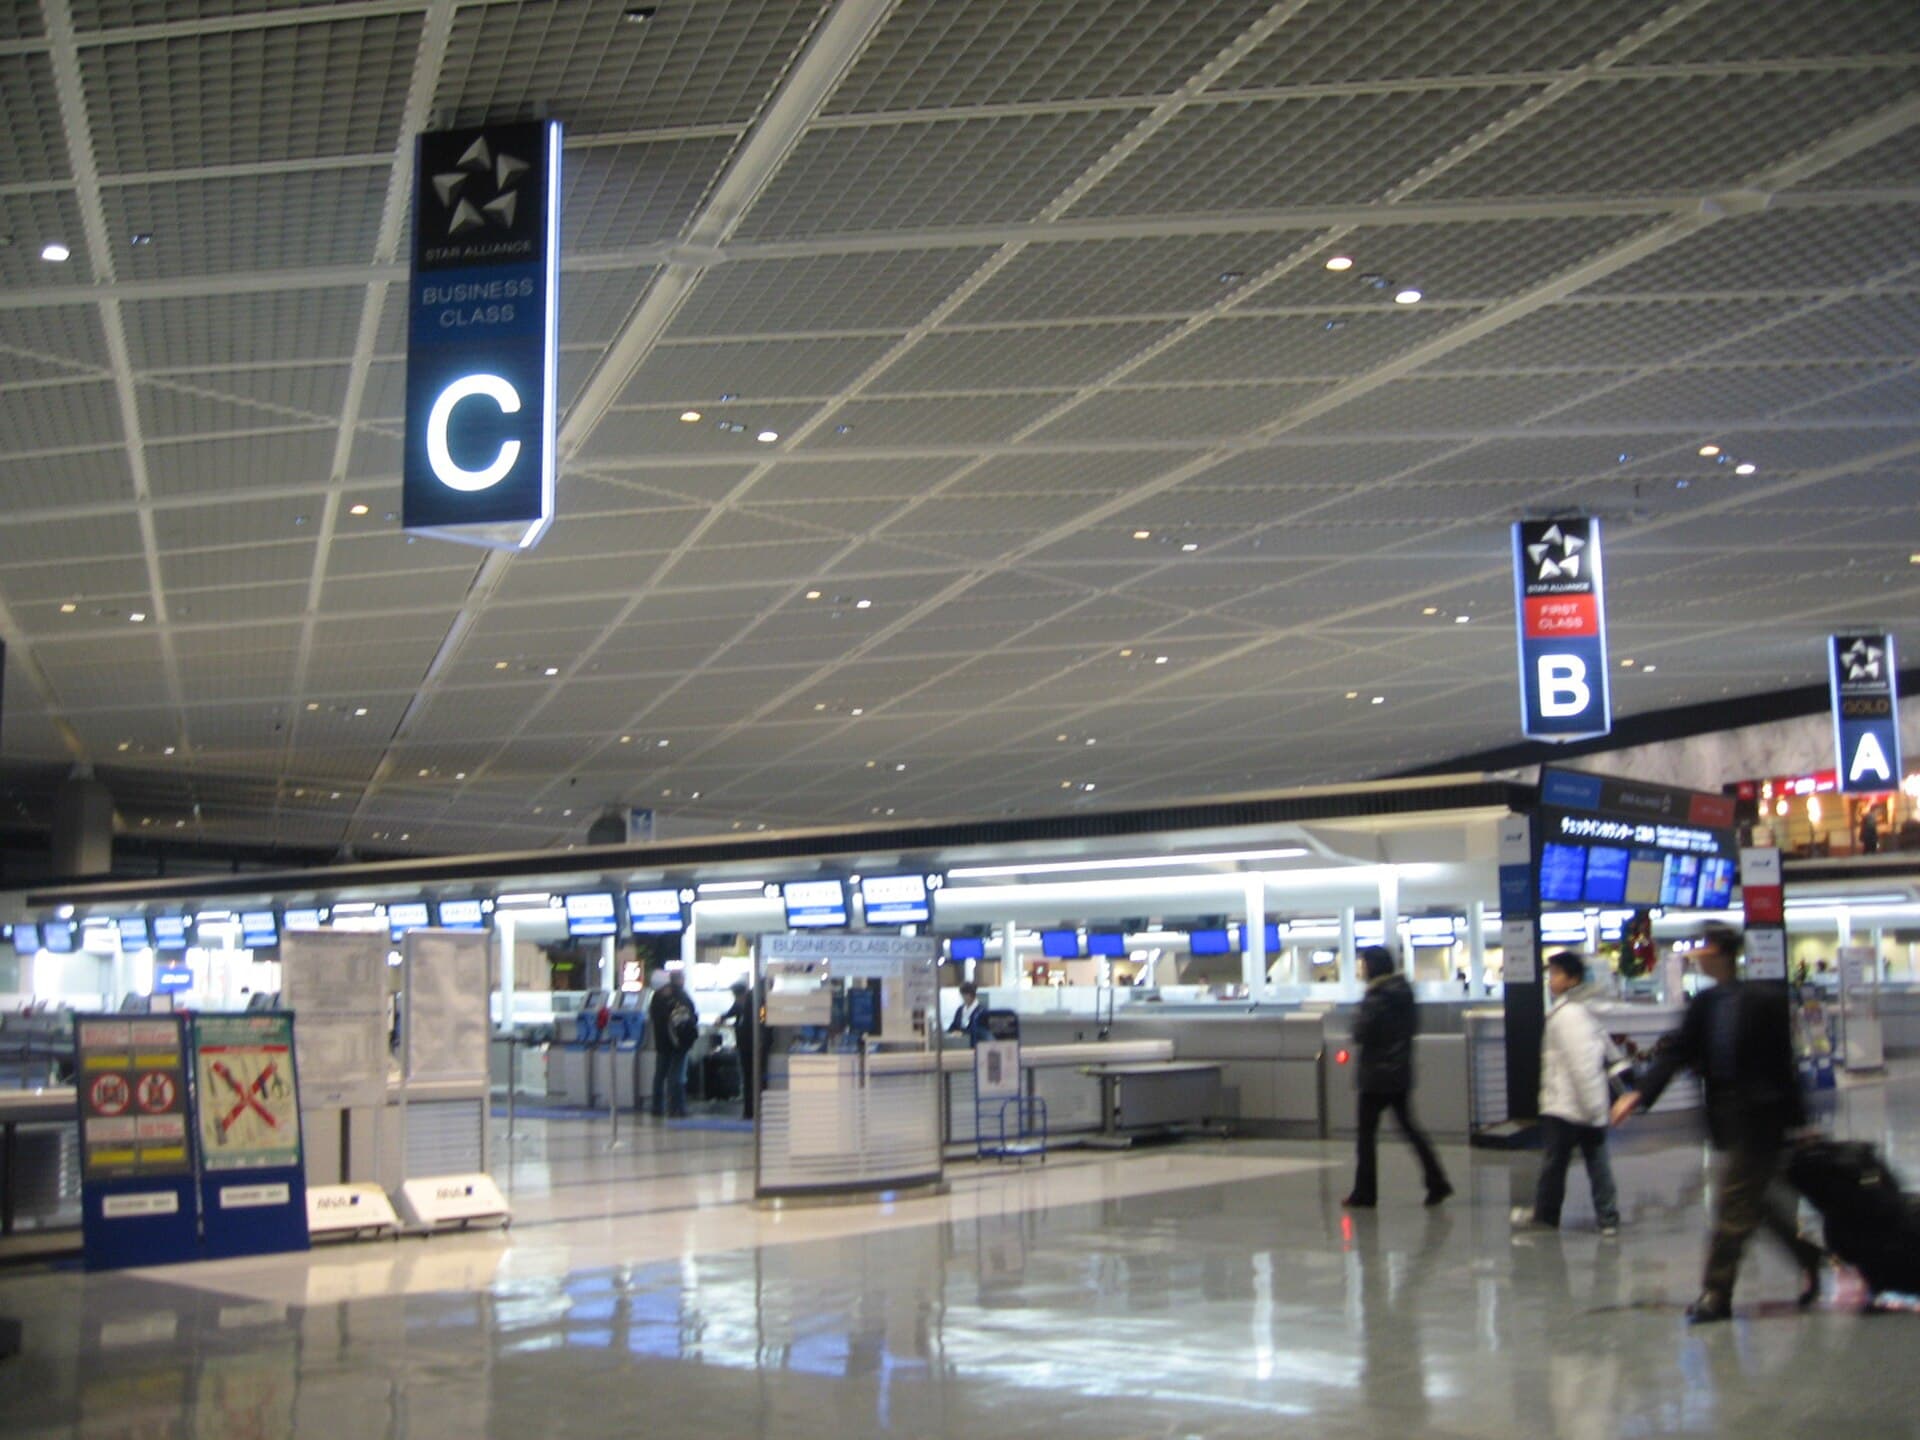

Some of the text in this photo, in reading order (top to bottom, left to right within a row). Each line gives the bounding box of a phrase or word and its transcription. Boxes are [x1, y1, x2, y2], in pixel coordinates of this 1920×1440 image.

[425, 239, 532, 262] STAR ALLIANCE
[422, 277, 534, 305] BUSINESS
[439, 303, 515, 328] CLASS
[426, 373, 521, 492] C
[1541, 603, 1578, 616] FIRST
[1538, 617, 1583, 630] CLASS
[1538, 654, 1590, 717] B
[1850, 732, 1890, 781] A
[773, 938, 847, 954] BUSINESS
[849, 938, 889, 954] CLASS
